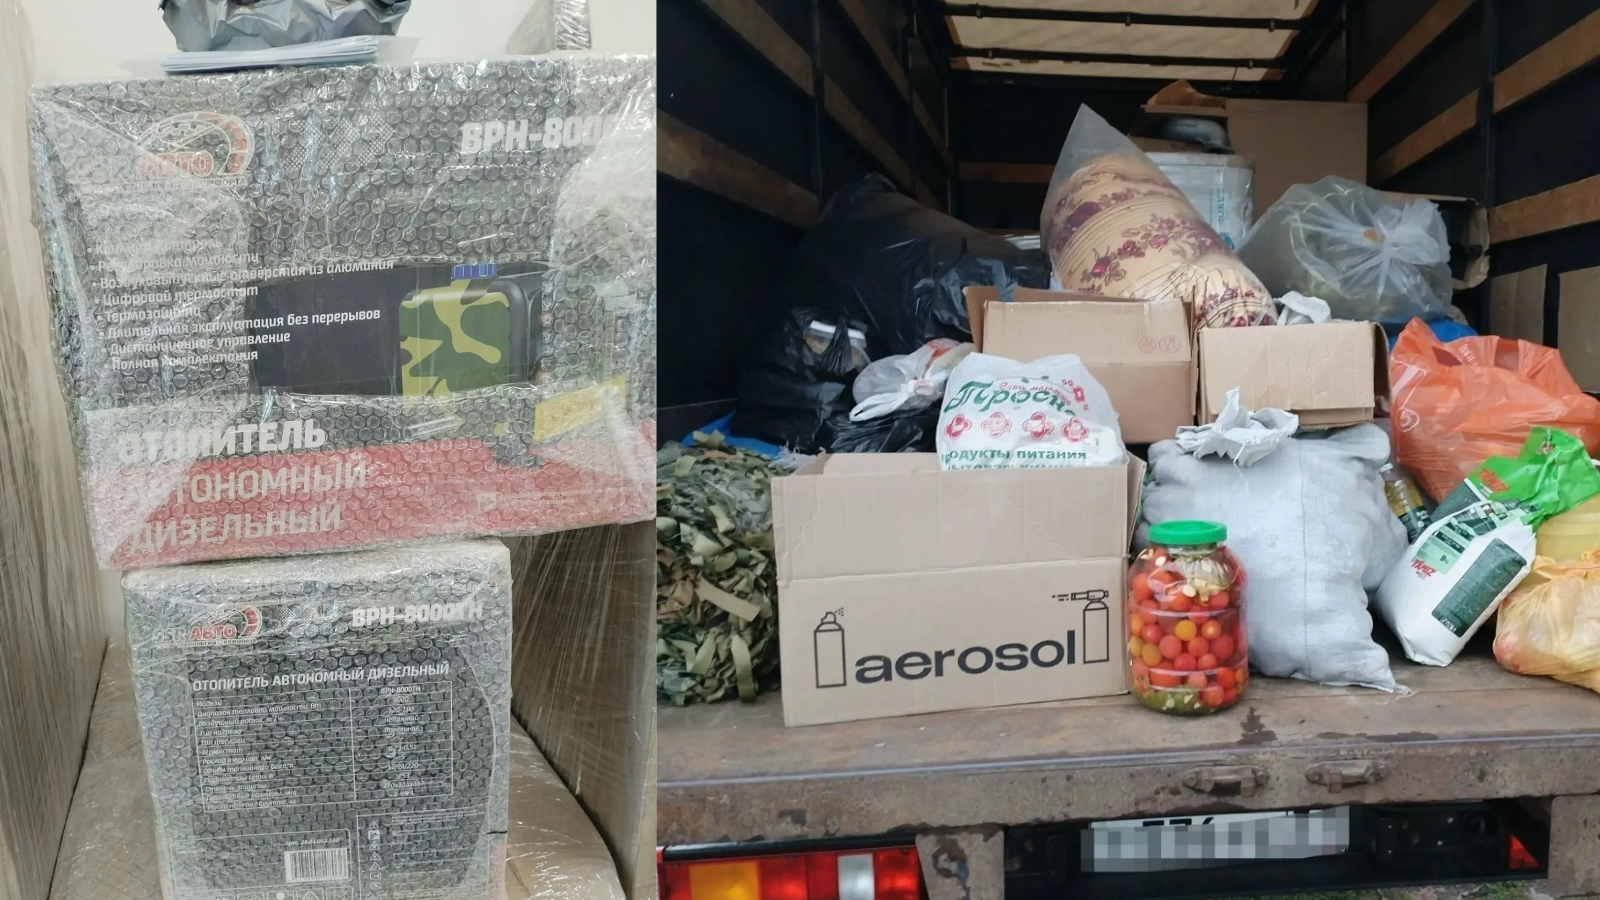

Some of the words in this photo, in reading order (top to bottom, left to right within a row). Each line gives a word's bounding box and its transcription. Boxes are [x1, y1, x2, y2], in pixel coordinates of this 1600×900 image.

[309, 264, 324, 276] из
[326, 259, 394, 274] алюминия
[102, 290, 172, 307] Цифровой
[174, 285, 258, 303] термостат
[107, 323, 189, 340] Длительная
[191, 317, 284, 334] эксплуатация
[287, 313, 309, 326] без
[311, 308, 381, 327] перерывов
[109, 337, 214, 356] Дистанционное
[216, 331, 290, 349] управление
[112, 357, 159, 371] Полная
[161, 350, 258, 368] комплектация
[117, 418, 327, 463] ОТОПИТЕЛЬ
[1016, 449, 1087, 460] питания
[126, 452, 366, 508] ТОНОМНЫЙ
[128, 499, 342, 555] ДИЗЕЛЬНЫЙ
[854, 629, 1076, 684] aerosol
[192, 676, 269, 692] ОТОПИТЕЛЬ
[272, 665, 364, 688] АВТОНОМНЫЙ
[367, 662, 450, 681] ДИЗЕЛЬНЫЙ
